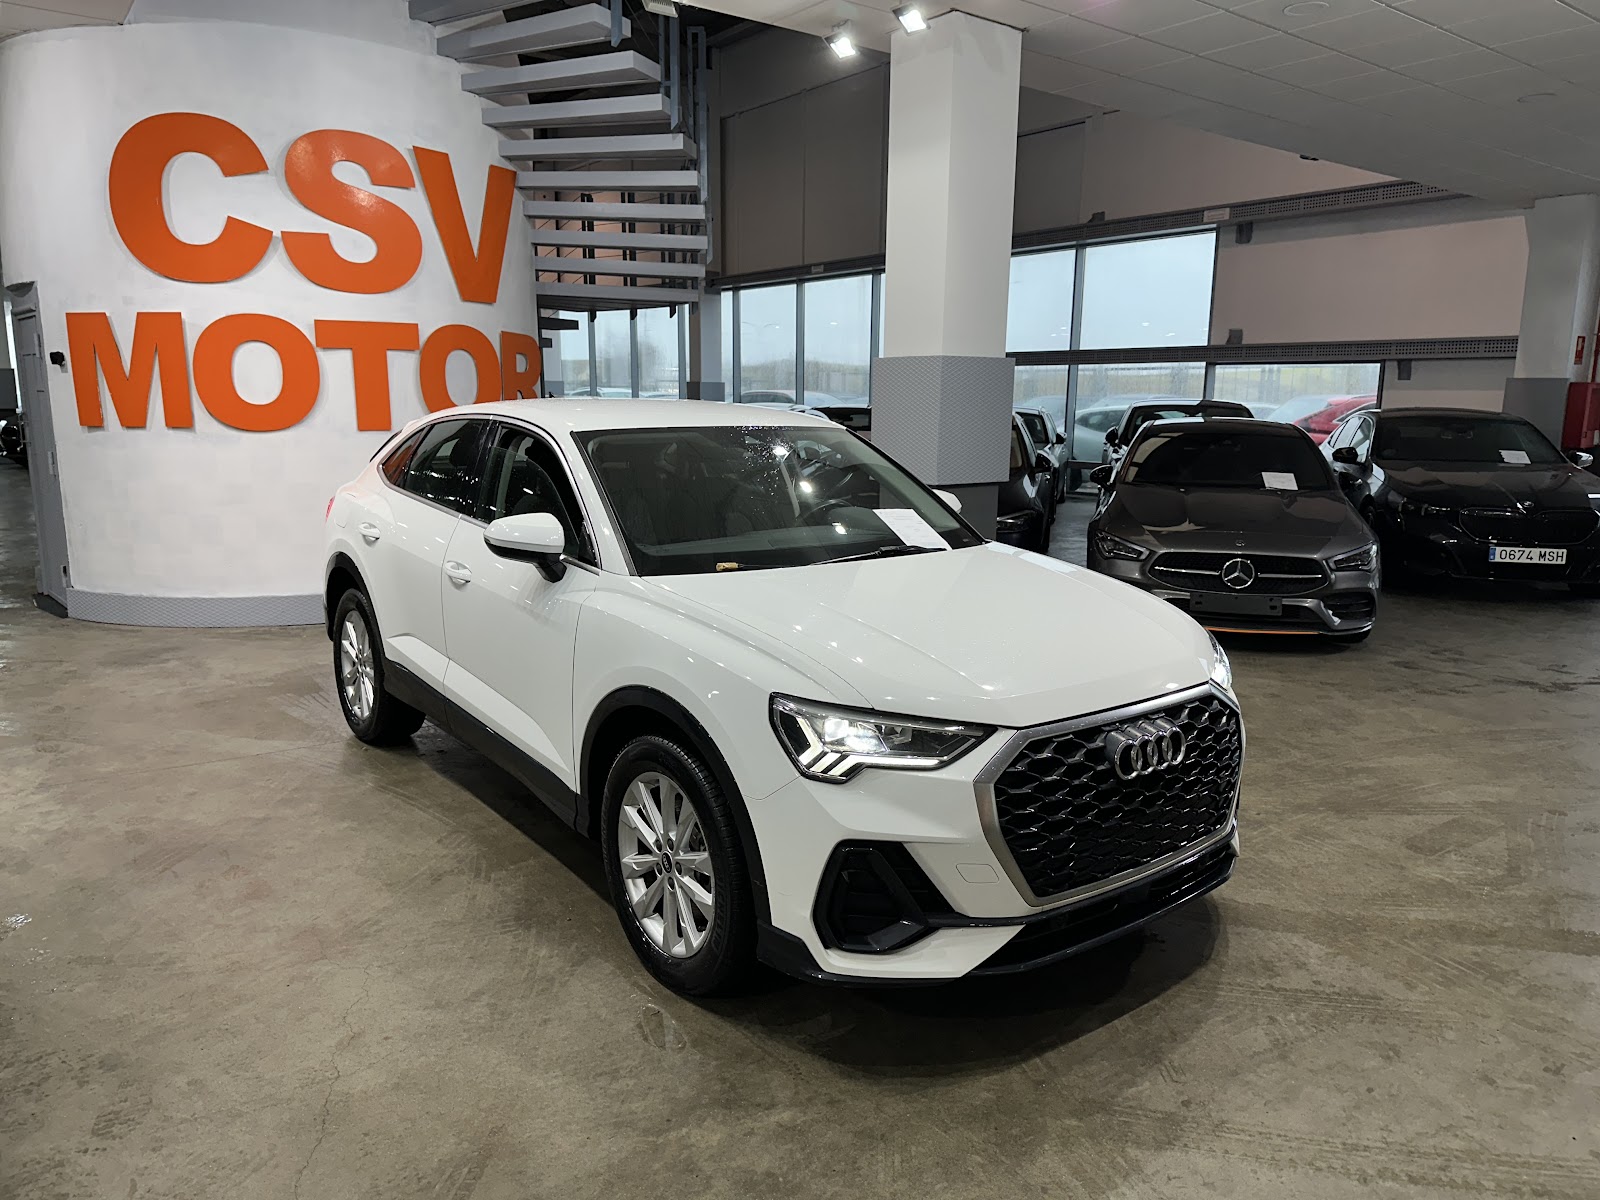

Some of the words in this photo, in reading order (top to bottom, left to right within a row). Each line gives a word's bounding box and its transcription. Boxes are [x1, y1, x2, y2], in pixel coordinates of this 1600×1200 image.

[109, 112, 517, 303] CSV
[66, 312, 542, 431] MOTOR
[1499, 549, 1534, 561] 0674
[1538, 550, 1565, 562] MSH
